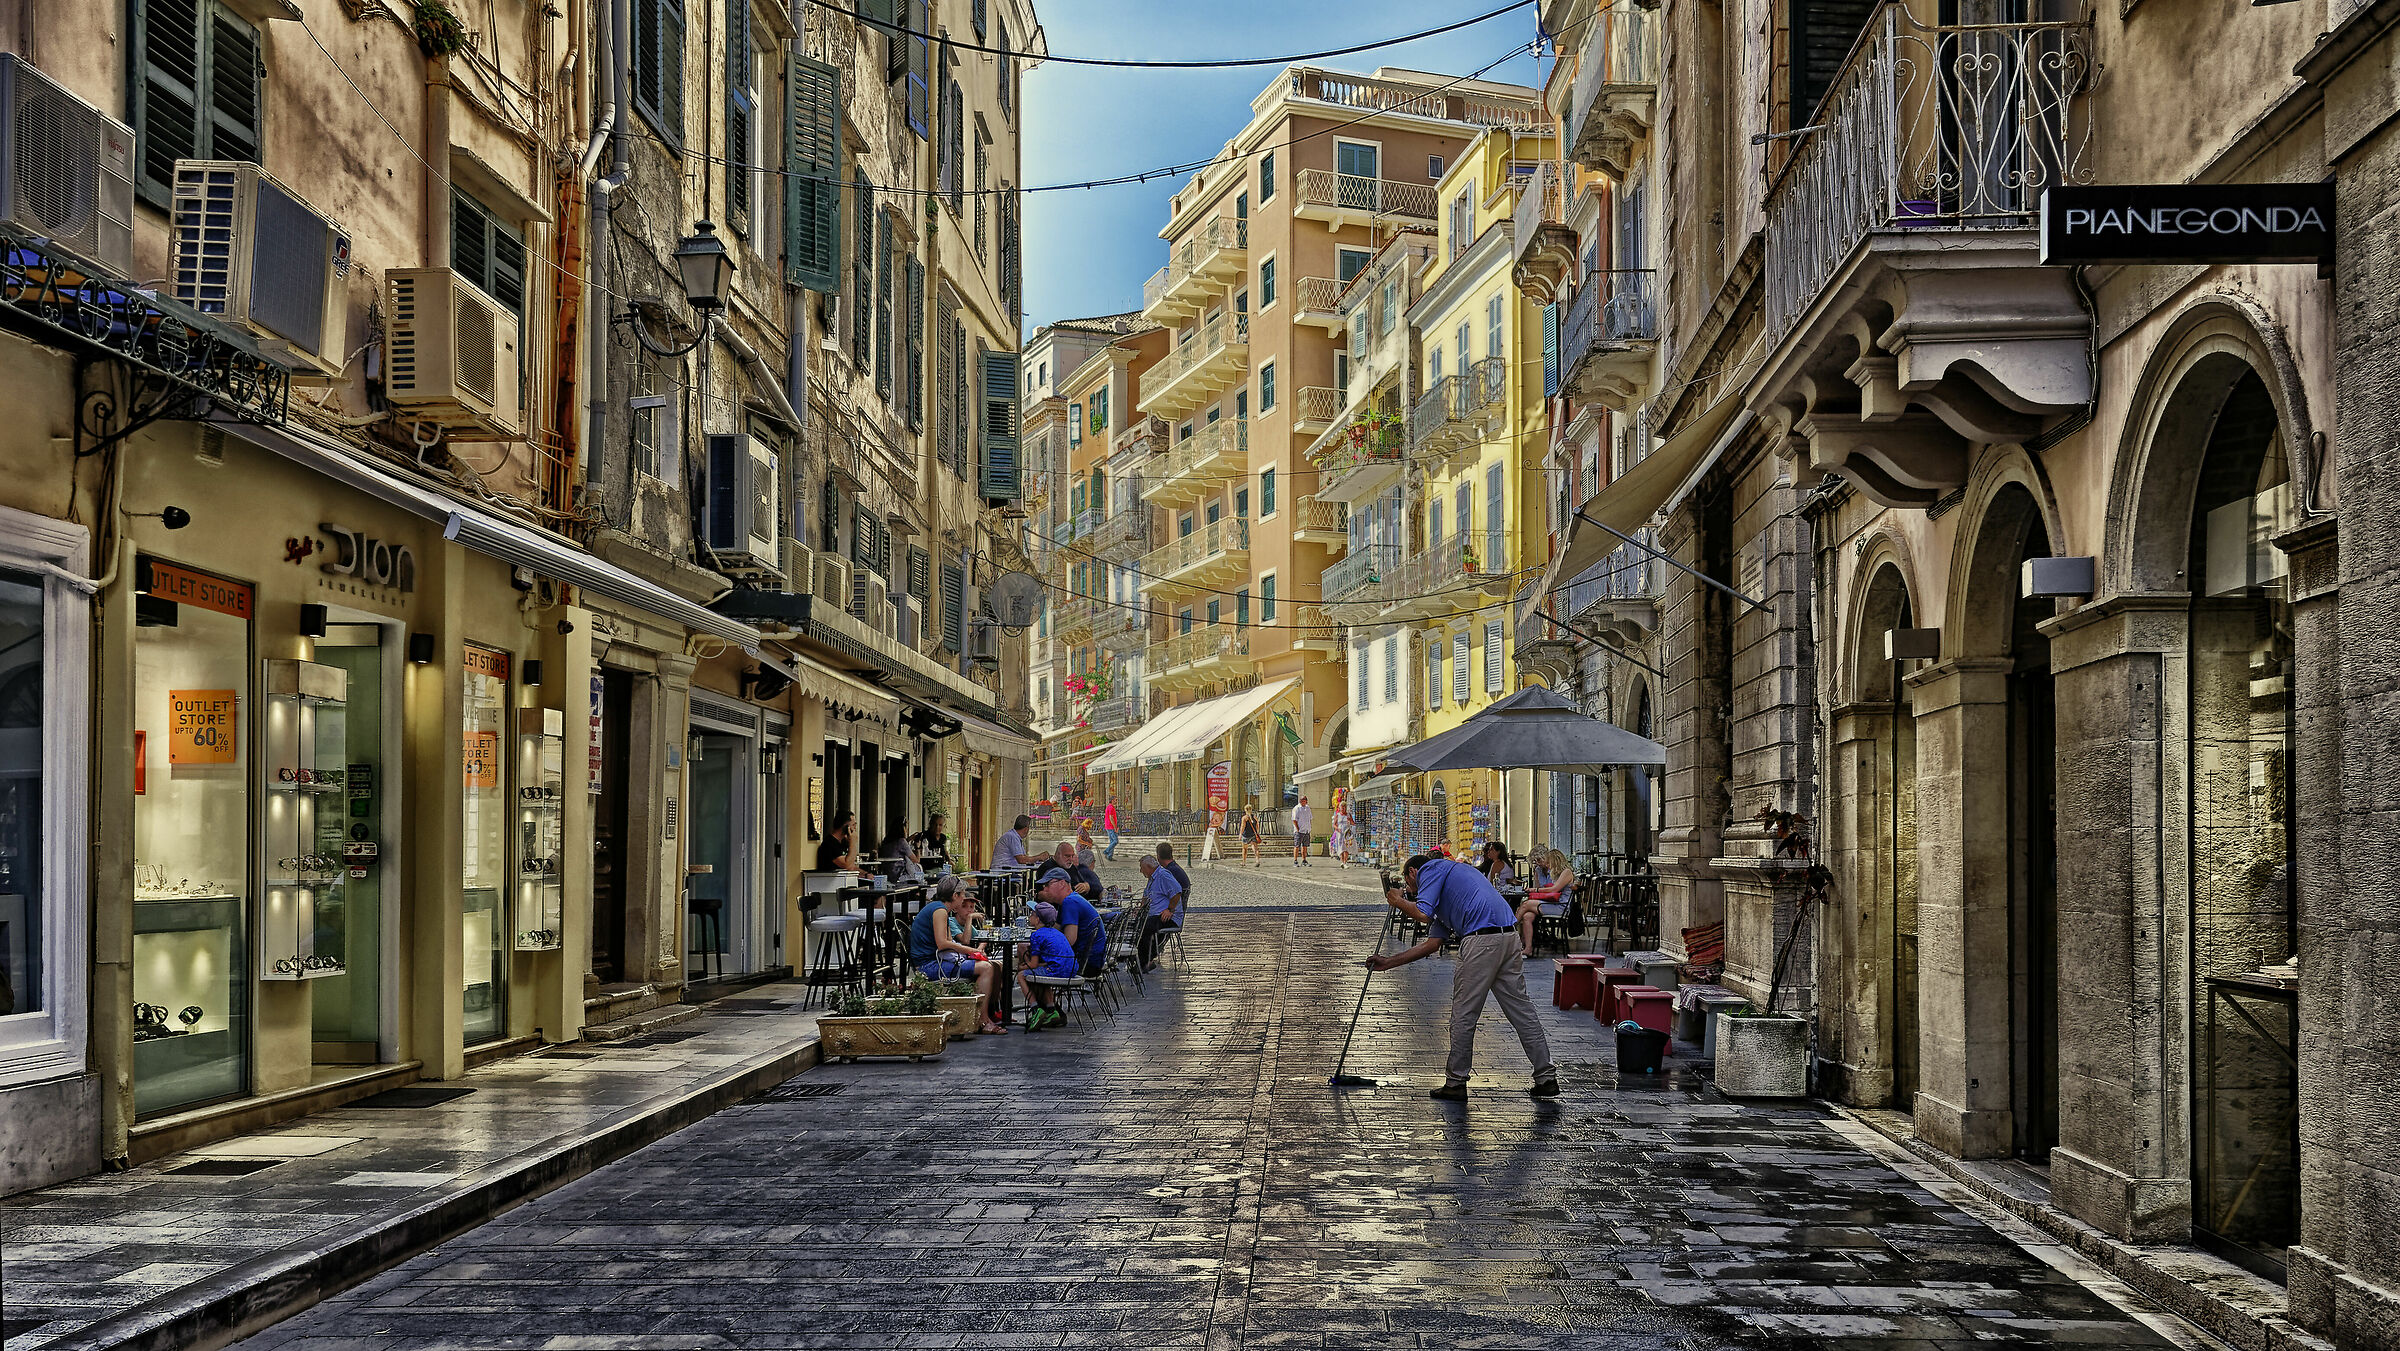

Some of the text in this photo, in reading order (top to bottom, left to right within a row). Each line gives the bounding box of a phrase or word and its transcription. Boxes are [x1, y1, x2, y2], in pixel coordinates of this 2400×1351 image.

[2065, 206, 2327, 235] PIANEGONDA
[331, 255, 350, 275] GREE
[151, 570, 245, 611] UTLET STORE
[463, 650, 505, 674] LET STORE
[175, 700, 229, 711] OUTLET
[179, 714, 226, 725] STORE
[466, 739, 493, 749] TLET
[467, 749, 489, 759] ORE
